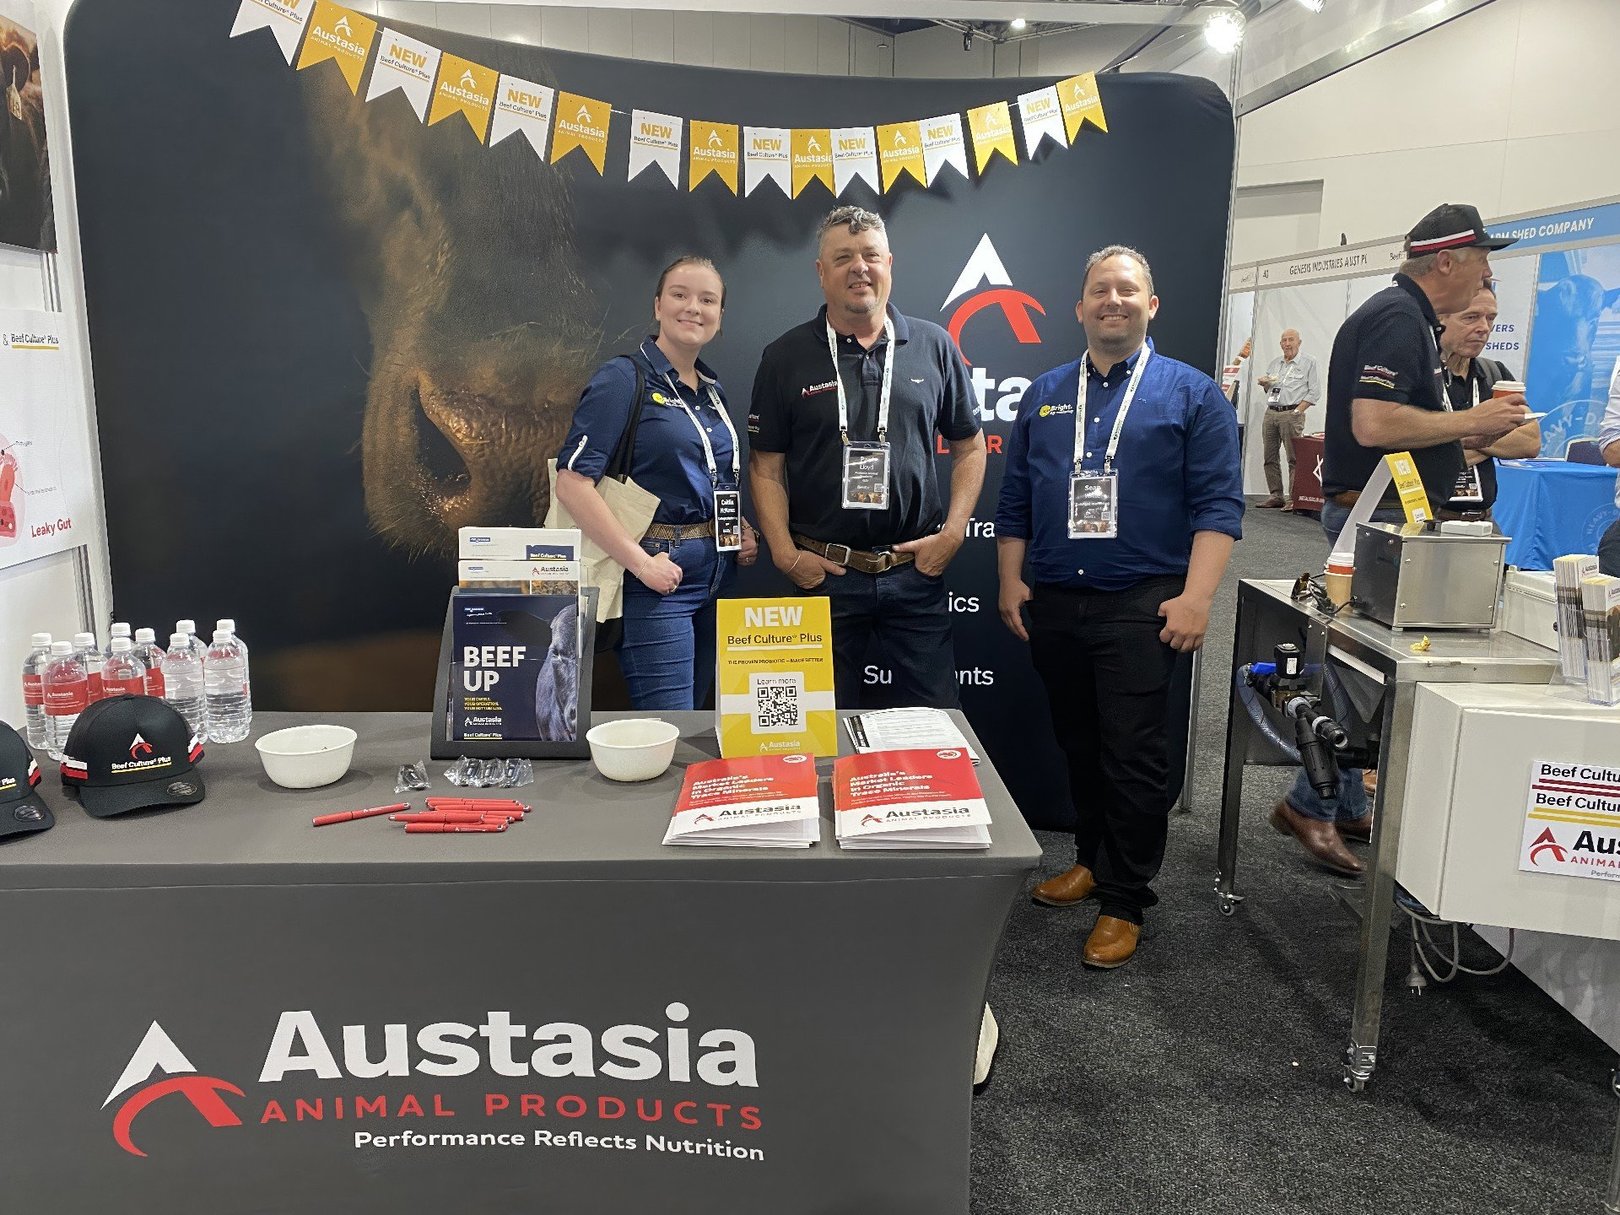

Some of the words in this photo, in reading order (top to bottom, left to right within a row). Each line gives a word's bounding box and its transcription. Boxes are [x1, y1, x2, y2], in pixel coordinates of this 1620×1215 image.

[313, 26, 366, 56] Austasia
[390, 43, 428, 68] NEW
[440, 81, 490, 106] Austasia
[507, 88, 542, 109] NEW
[1027, 97, 1052, 113] NEW
[559, 119, 605, 138] Austasia
[640, 122, 673, 139] NEW
[927, 125, 954, 141] NEW
[693, 146, 736, 158] Austasia
[752, 138, 782, 151] NEW
[839, 138, 866, 150] NEW
[1511, 226, 1536, 241] SHED
[1538, 217, 1594, 237] COMPANY
[1289, 263, 1311, 275] GENESIS
[1312, 257, 1343, 272] INDUSTRIES
[1485, 342, 1519, 351] SHEDS
[31, 522, 56, 538] Leaky
[57, 518, 72, 531] Gut
[744, 606, 803, 627] NEW
[727, 634, 751, 645] Beef
[800, 632, 823, 642] Plus
[464, 646, 526, 668] BEEF
[464, 671, 499, 692] UP
[111, 762, 128, 770] Beef
[157, 756, 171, 764] Plus
[1541, 764, 1577, 778] Beef
[850, 778, 888, 787] Market
[691, 791, 720, 799] Trace
[723, 786, 769, 795] Minerals
[850, 789, 881, 797] Trace
[1535, 793, 1572, 808] Beef
[719, 804, 801, 816] Austasia
[886, 806, 970, 818] Austasia
[258, 1001, 760, 1089] Austasia
[261, 1094, 456, 1124] ANIMAL
[486, 1094, 764, 1131] PRODUCTS
[354, 1130, 526, 1149] Performance
[534, 1130, 637, 1151] Reflects
[646, 1132, 765, 1161] Nutrition
